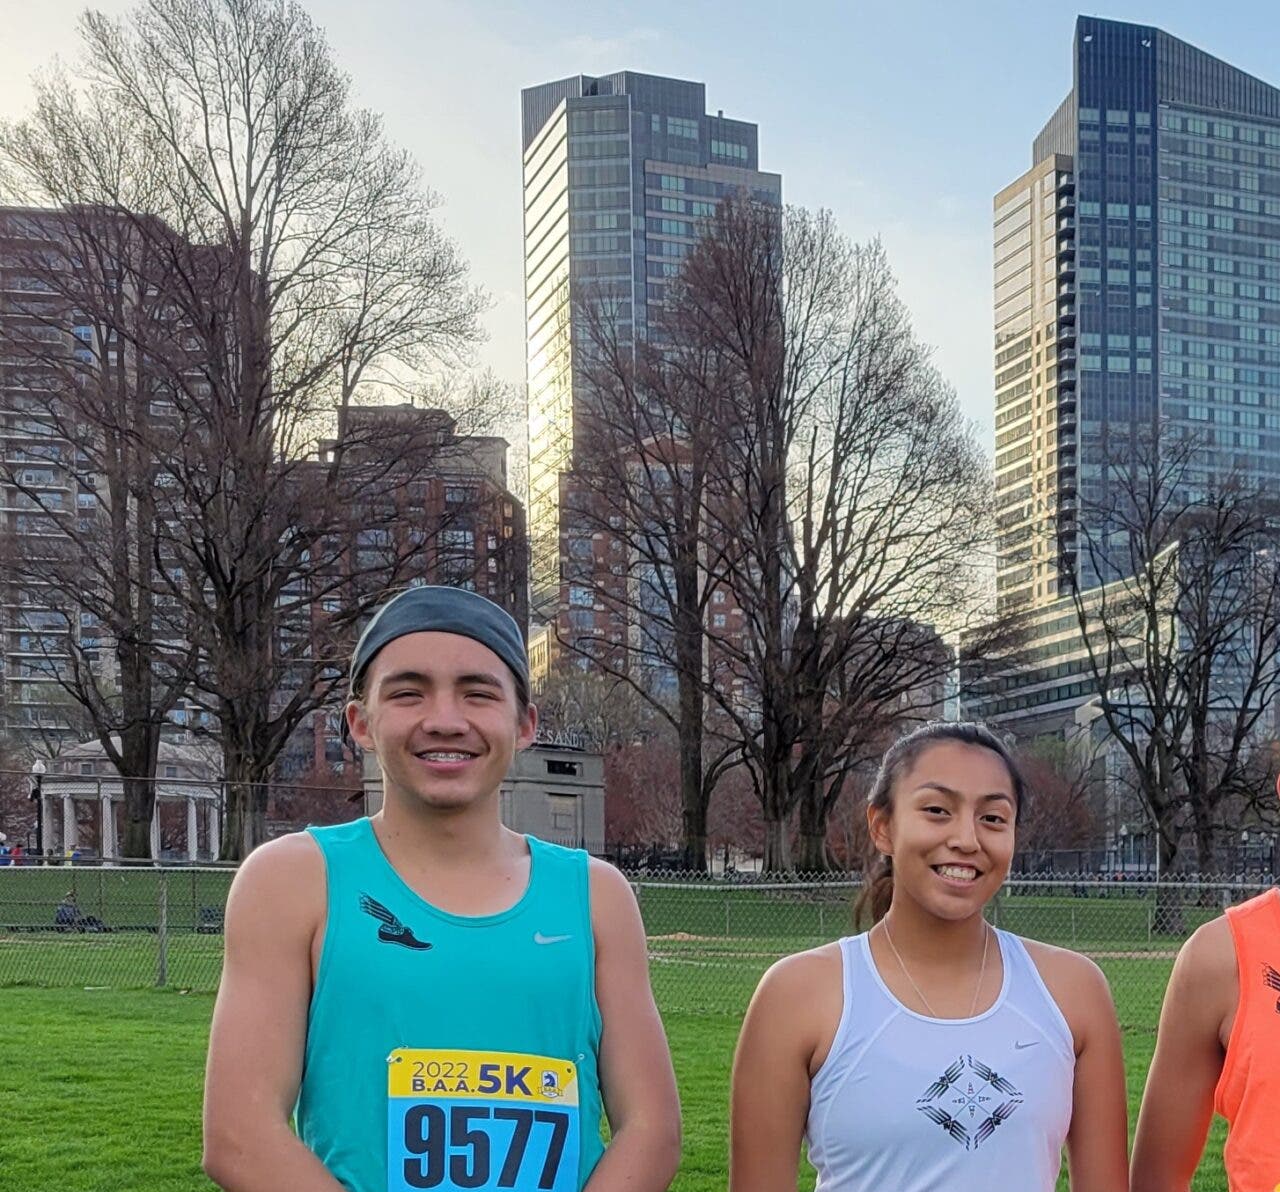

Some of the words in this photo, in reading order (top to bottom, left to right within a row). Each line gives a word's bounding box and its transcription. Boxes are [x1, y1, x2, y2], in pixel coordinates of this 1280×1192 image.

[412, 1061, 469, 1078] 2022
[412, 1079, 475, 1093] B.A.A.
[477, 1064, 534, 1097] 5K
[404, 1104, 569, 1190] 9577
